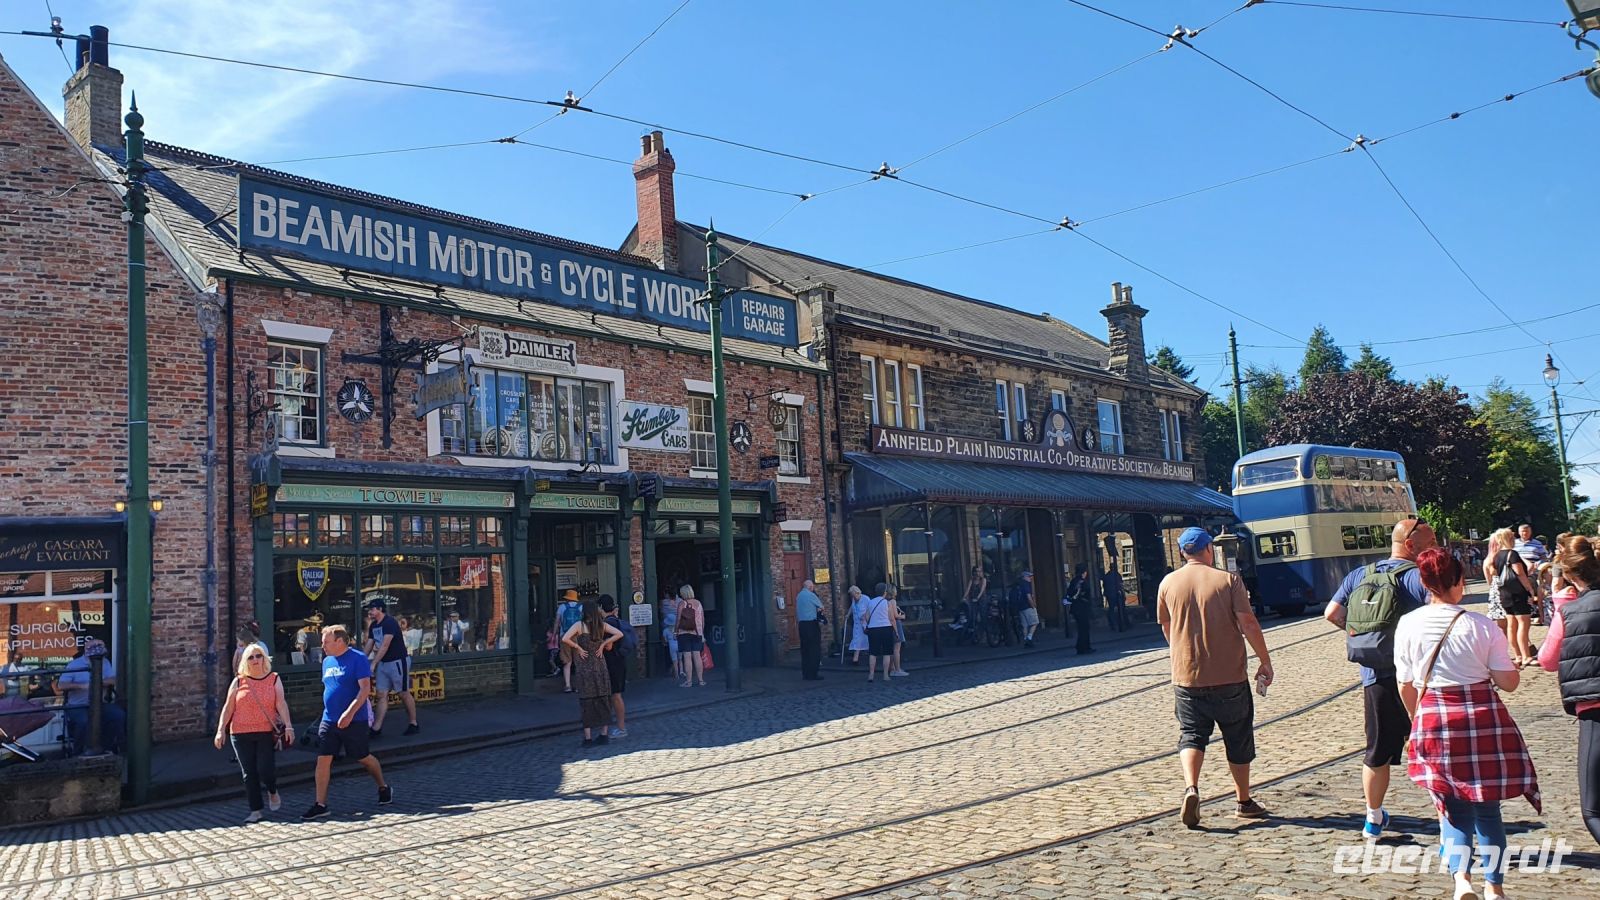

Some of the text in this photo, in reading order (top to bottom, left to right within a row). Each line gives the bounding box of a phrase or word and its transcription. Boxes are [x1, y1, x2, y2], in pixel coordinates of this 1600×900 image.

[253, 192, 722, 324] BEAMISH MOTOR & CYCLE WORK
[742, 298, 785, 321] REPAIRS
[743, 315, 785, 337] GARAGE
[509, 339, 571, 361] DAIMLER
[621, 407, 680, 442] Humber
[661, 430, 687, 448] CARS
[878, 429, 943, 453] ANNFIELD
[946, 436, 982, 457] PLAIN
[984, 441, 1046, 464] INDUSTRIAL
[1047, 449, 1117, 471] CO-OPERATIVE
[1118, 457, 1154, 474] SOCIETY
[1163, 462, 1193, 478] BEAMISH
[360, 488, 372, 502] T
[374, 489, 426, 504] COWIE
[576, 496, 605, 509] COWIE
[10, 622, 87, 636] SURGICAL
[417, 688, 443, 699] SPIRIT
